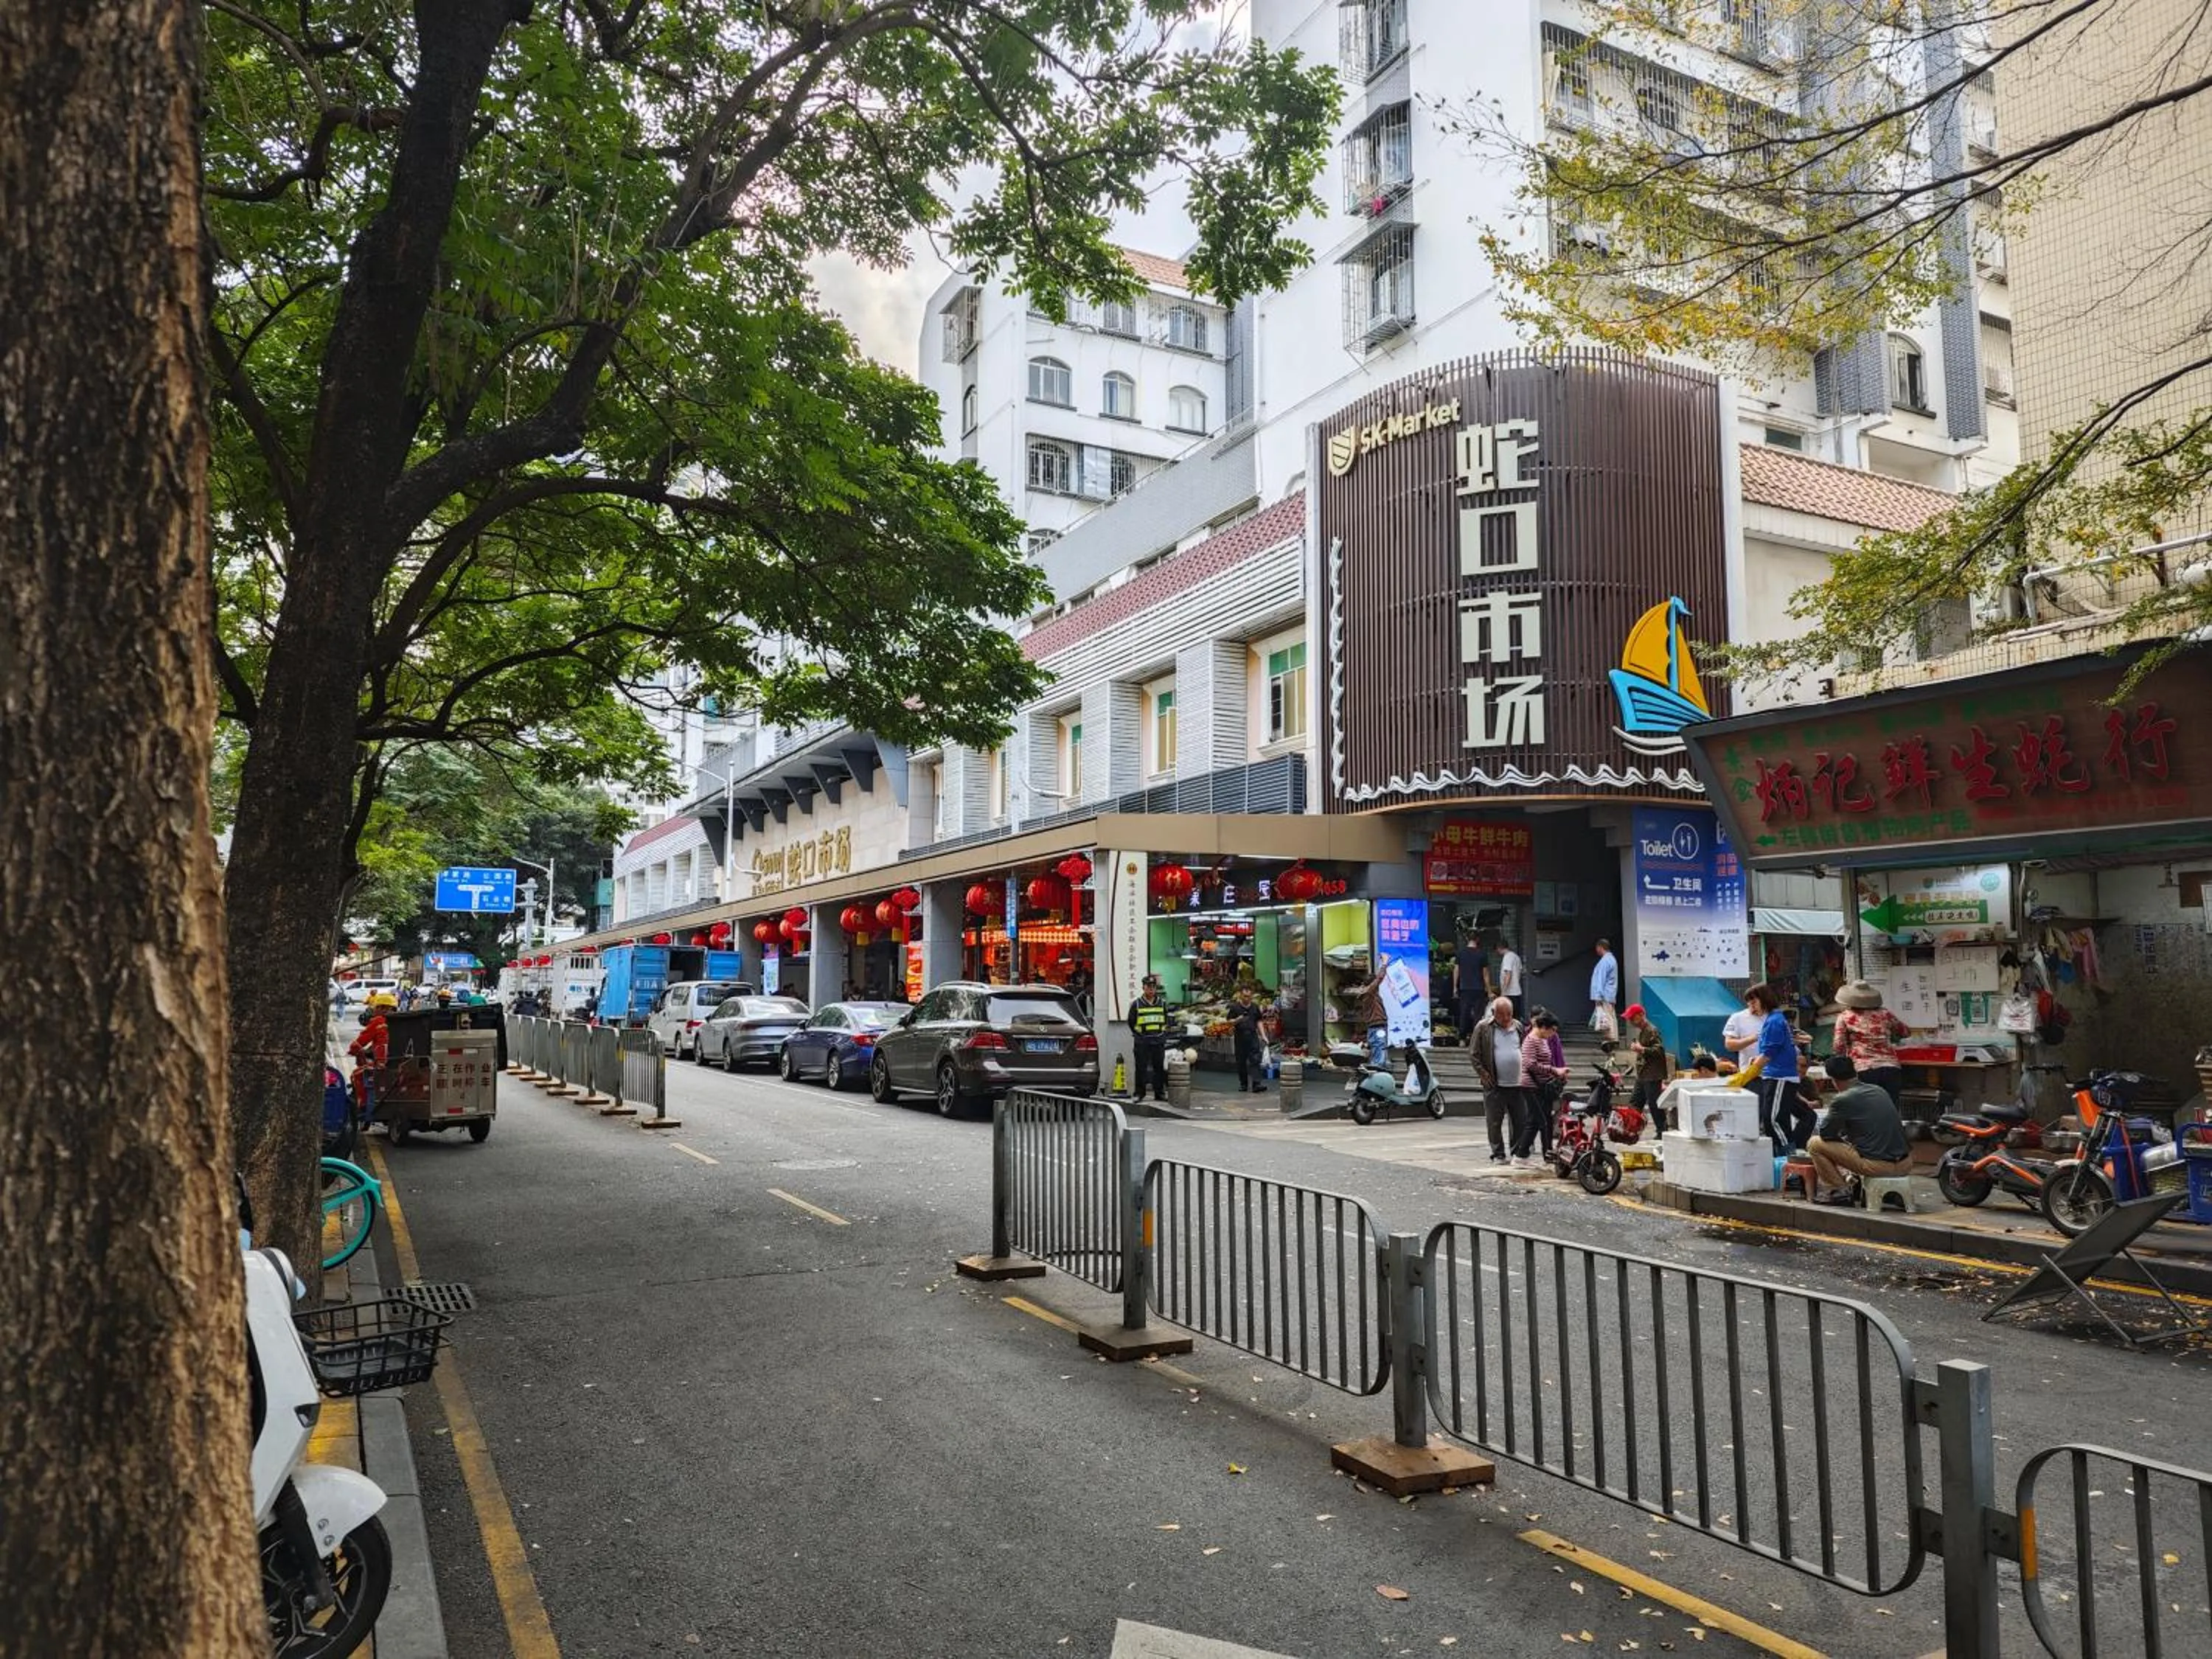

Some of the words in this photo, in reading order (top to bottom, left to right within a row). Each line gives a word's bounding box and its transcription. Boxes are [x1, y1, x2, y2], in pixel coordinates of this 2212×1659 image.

[1360, 397, 1461, 455] SK-Market
[1455, 418, 1545, 749] 蛇口市场
[787, 825, 852, 886] 蛇口市场
[1641, 839, 1674, 858] Toilet
[1672, 877, 1703, 891] 卫生间
[437, 1062, 491, 1074] 正在作业
